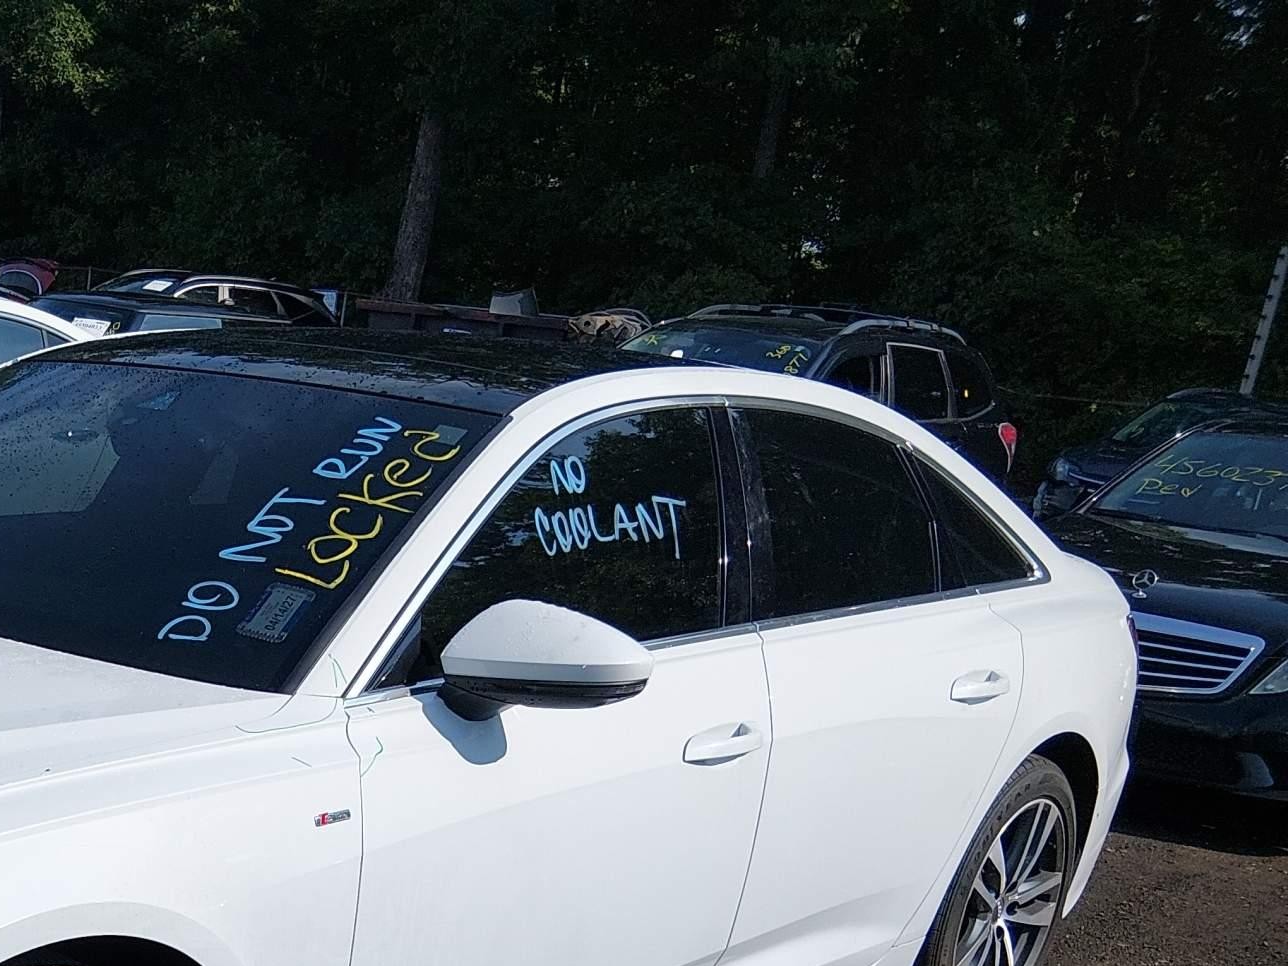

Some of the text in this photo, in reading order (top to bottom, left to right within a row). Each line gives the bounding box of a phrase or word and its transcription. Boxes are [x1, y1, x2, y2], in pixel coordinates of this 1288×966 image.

[549, 455, 586, 495] NO
[158, 416, 401, 641] DO NOT RUN
[533, 495, 686, 560] COOLANT
[264, 595, 297, 631] 04/14/27
